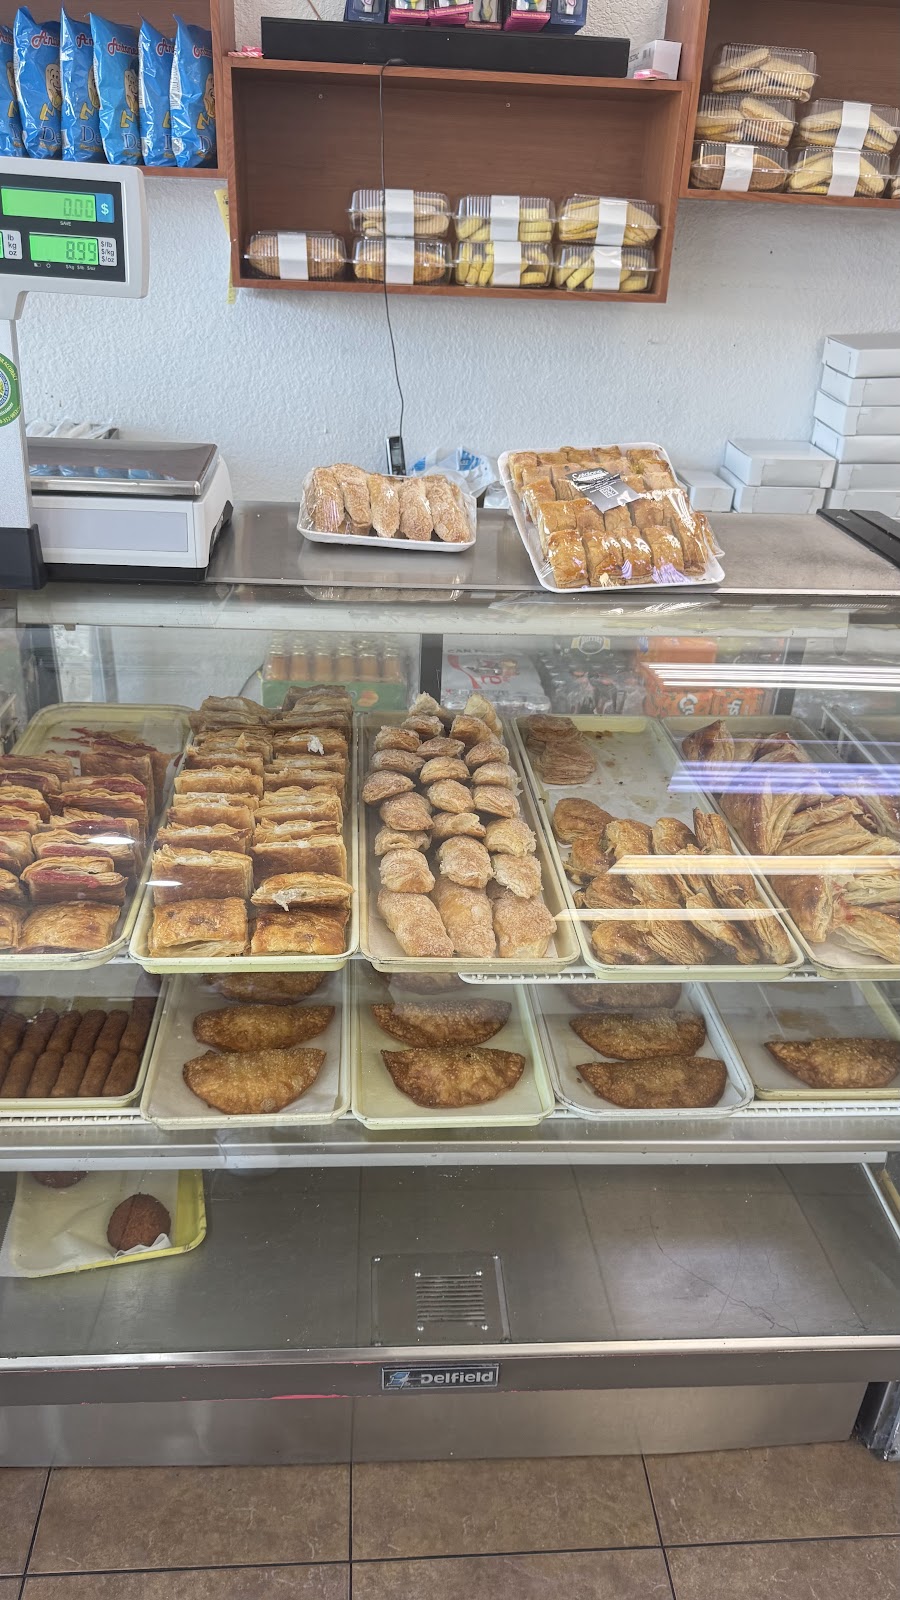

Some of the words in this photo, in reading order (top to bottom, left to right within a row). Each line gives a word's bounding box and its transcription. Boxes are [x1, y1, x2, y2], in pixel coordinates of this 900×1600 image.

[101, 203, 109, 216] $
[8, 242, 17, 250] kg
[66, 240, 96, 262] 8.99
[101, 248, 115, 256] $/kg
[421, 1371, 494, 1384] Delfield
